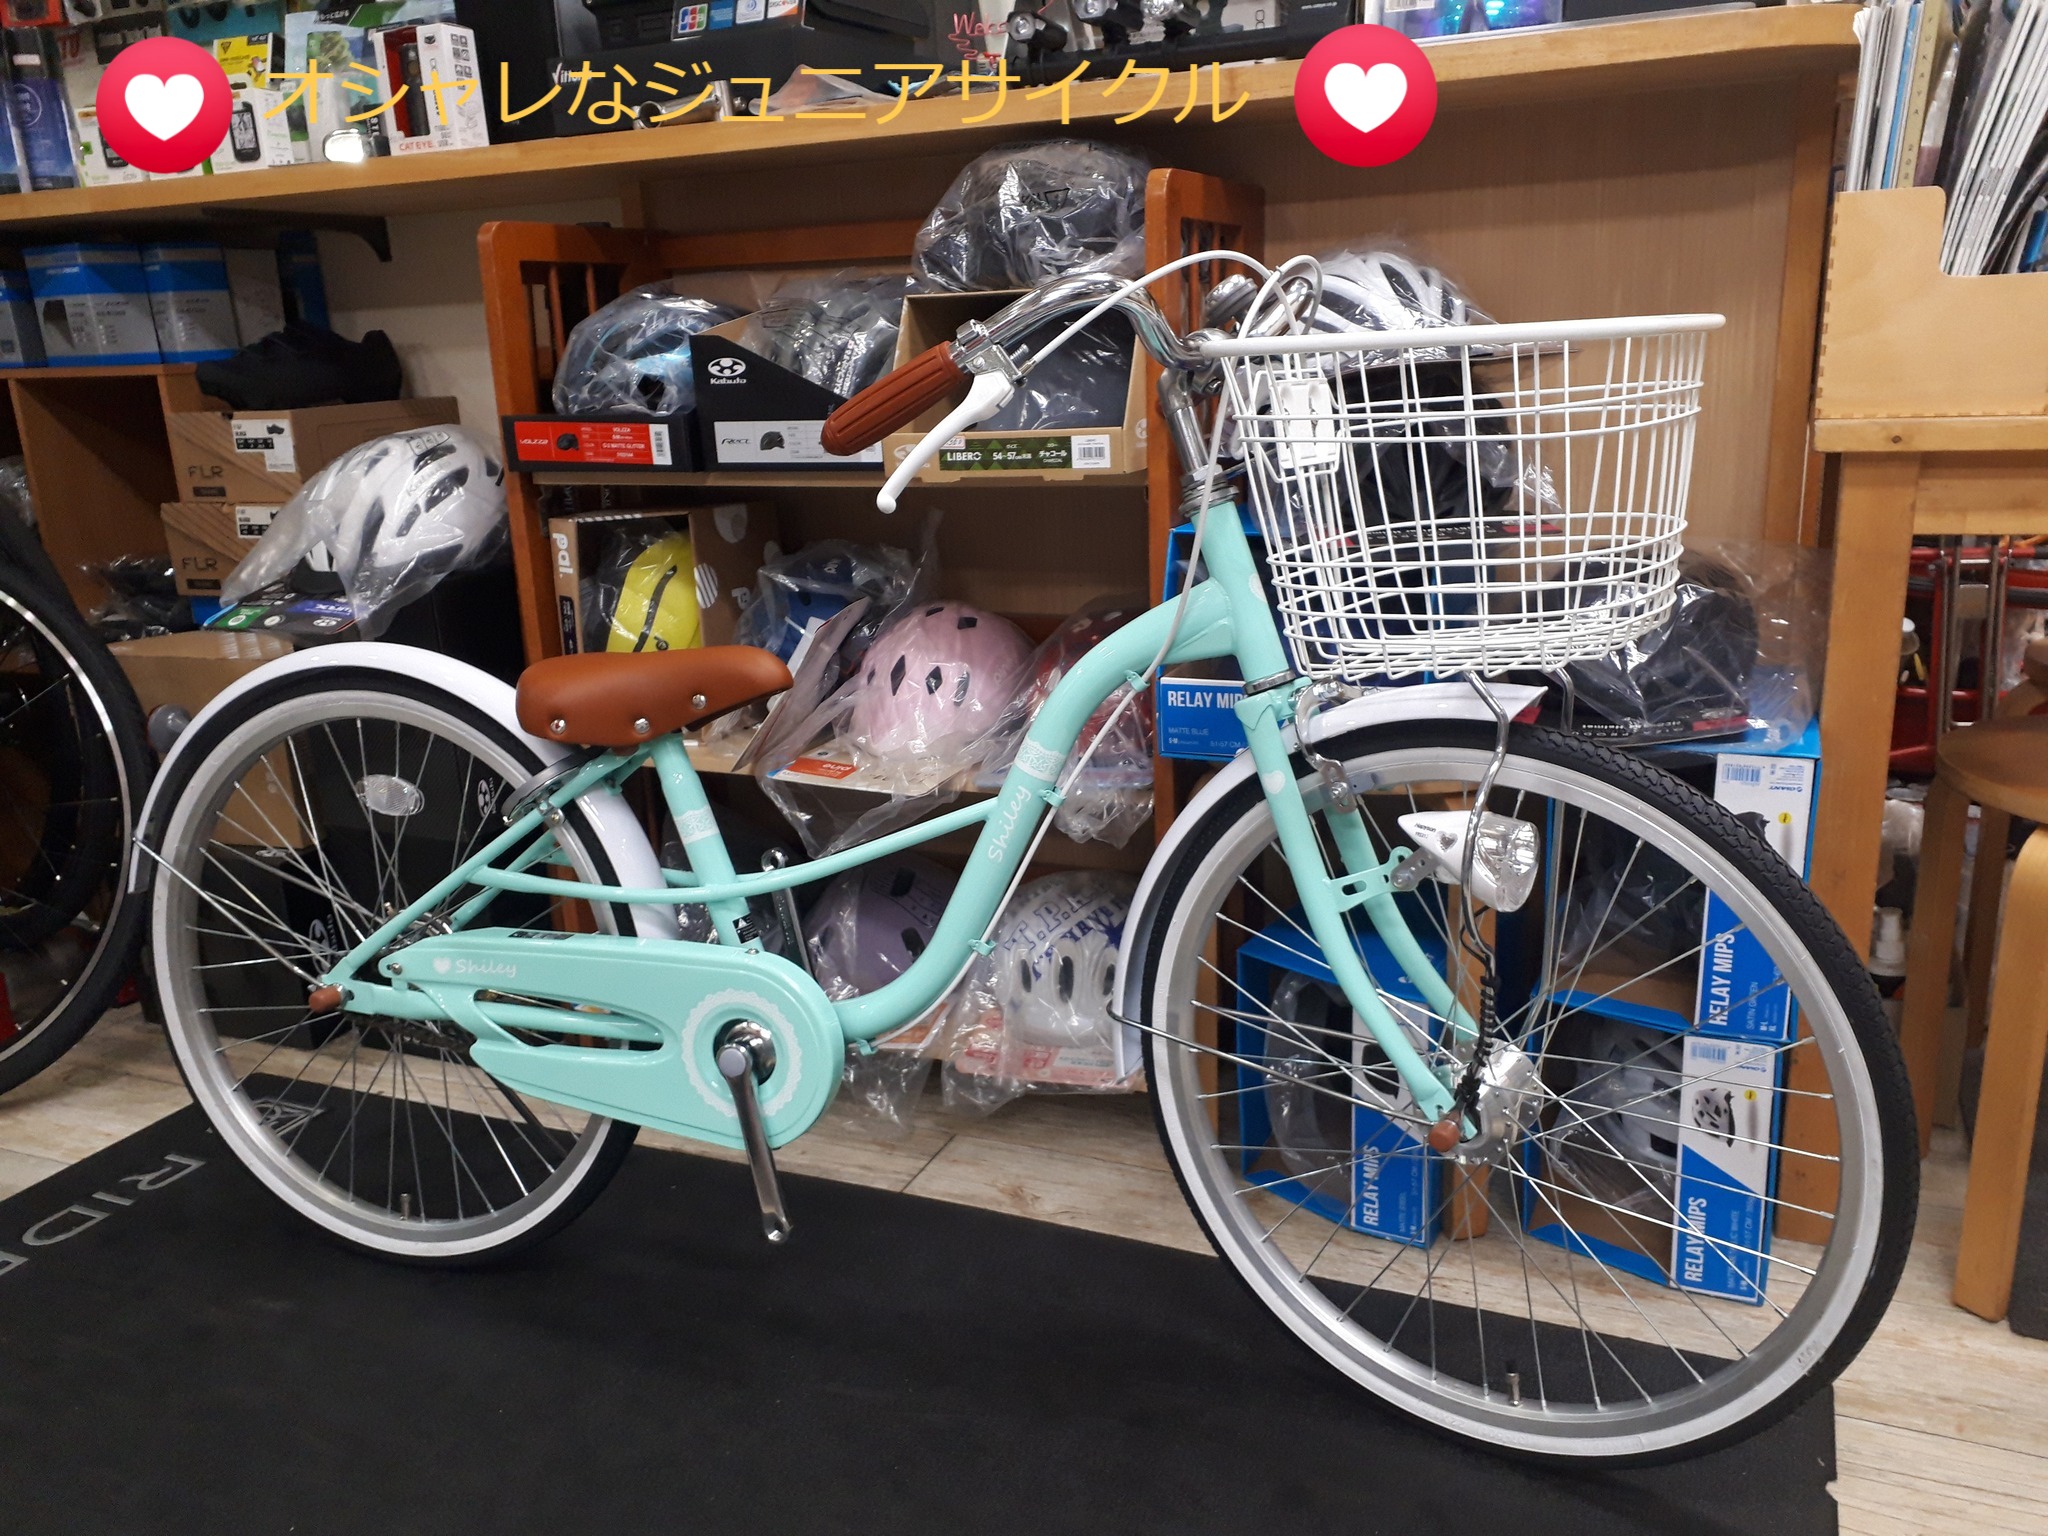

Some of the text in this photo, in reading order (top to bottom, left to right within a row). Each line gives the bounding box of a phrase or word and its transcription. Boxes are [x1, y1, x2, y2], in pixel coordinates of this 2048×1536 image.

[710, 377, 747, 385] Kabuto
[947, 451, 982, 461] LIBERO
[1038, 449, 1068, 458] チャコール
[187, 465, 224, 479] FLR
[182, 556, 217, 571] FLR
[1167, 690, 1213, 708] RELAY
[1168, 727, 1209, 736] MATTE BLUE
[988, 785, 1032, 864] Shiley
[456, 958, 517, 978] Shiley
[1708, 932, 1736, 1026] RELAY MIPS
[1362, 1184, 1379, 1226] RELAY
[1684, 1235, 1706, 1282] RELAY
